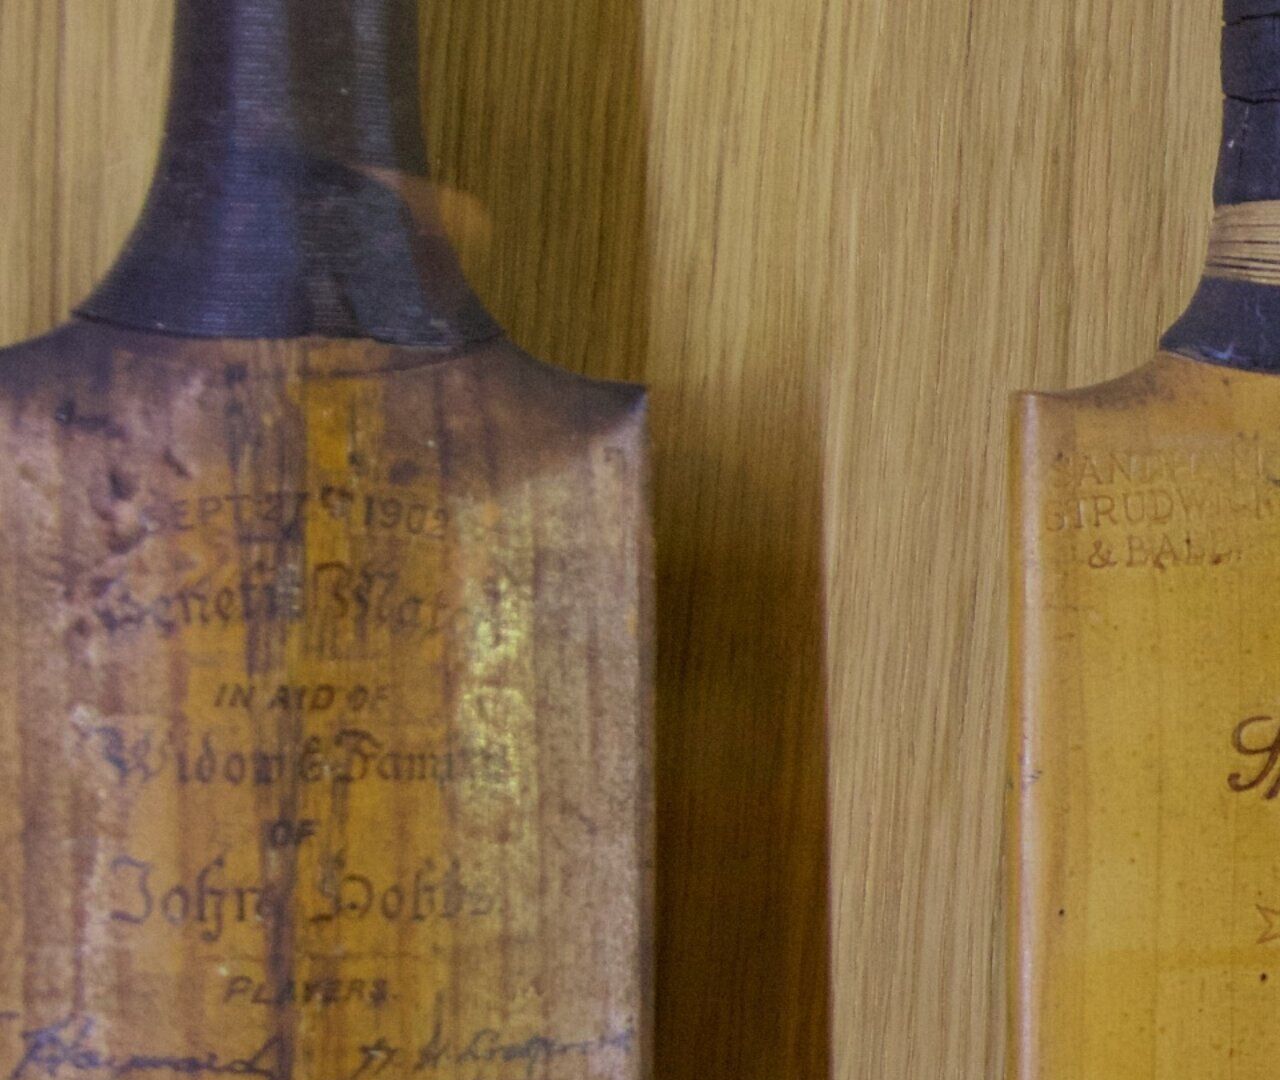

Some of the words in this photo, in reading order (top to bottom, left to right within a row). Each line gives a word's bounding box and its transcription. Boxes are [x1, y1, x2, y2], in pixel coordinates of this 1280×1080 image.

[1088, 537, 1119, 569] &
[213, 684, 254, 709] IN
[267, 683, 335, 712] AID
[350, 683, 390, 712] OF
[269, 817, 317, 847] OF
